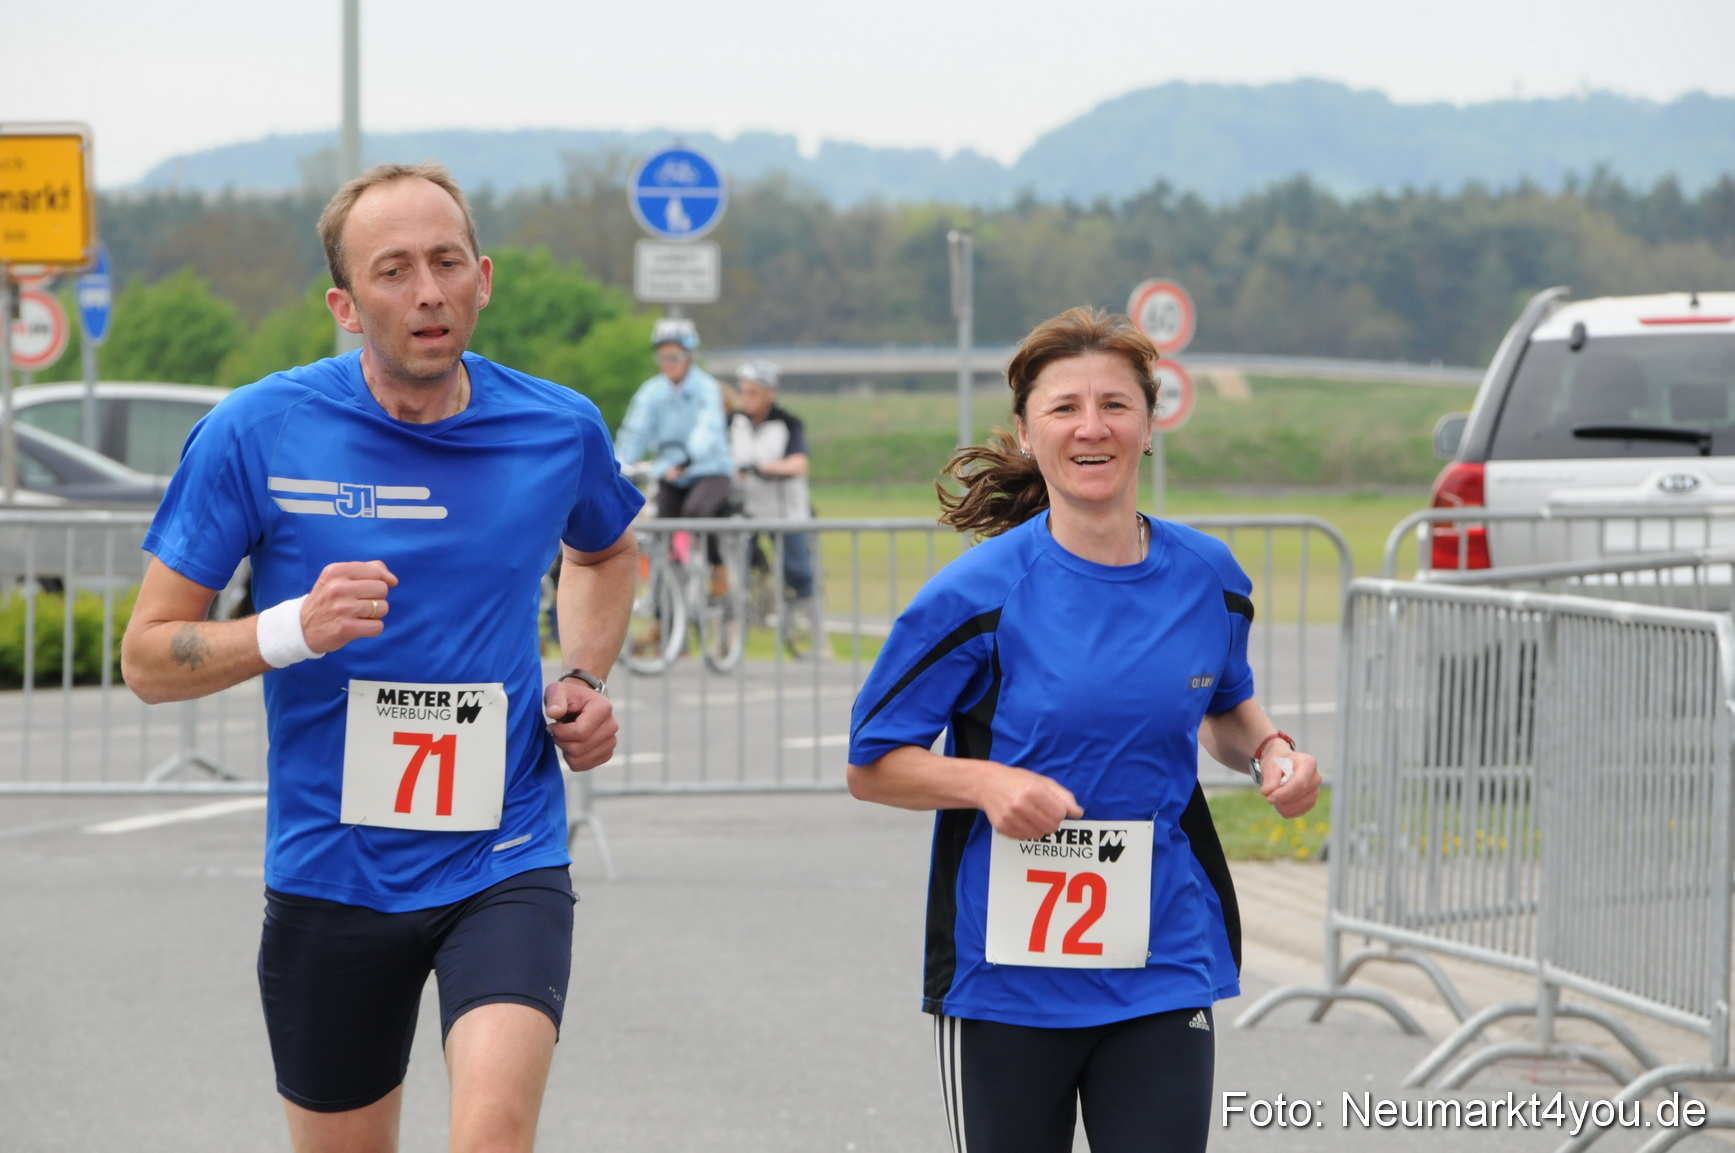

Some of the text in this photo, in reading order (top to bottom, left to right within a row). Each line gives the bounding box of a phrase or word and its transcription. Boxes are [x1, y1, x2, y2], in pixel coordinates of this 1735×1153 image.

[376, 688, 451, 707] MEYER
[376, 705, 451, 721] WERBUNG
[393, 731, 457, 816] 71
[1024, 828, 1093, 845] EYER
[1019, 843, 1094, 859] WERBUNG
[1027, 869, 1107, 956] 72
